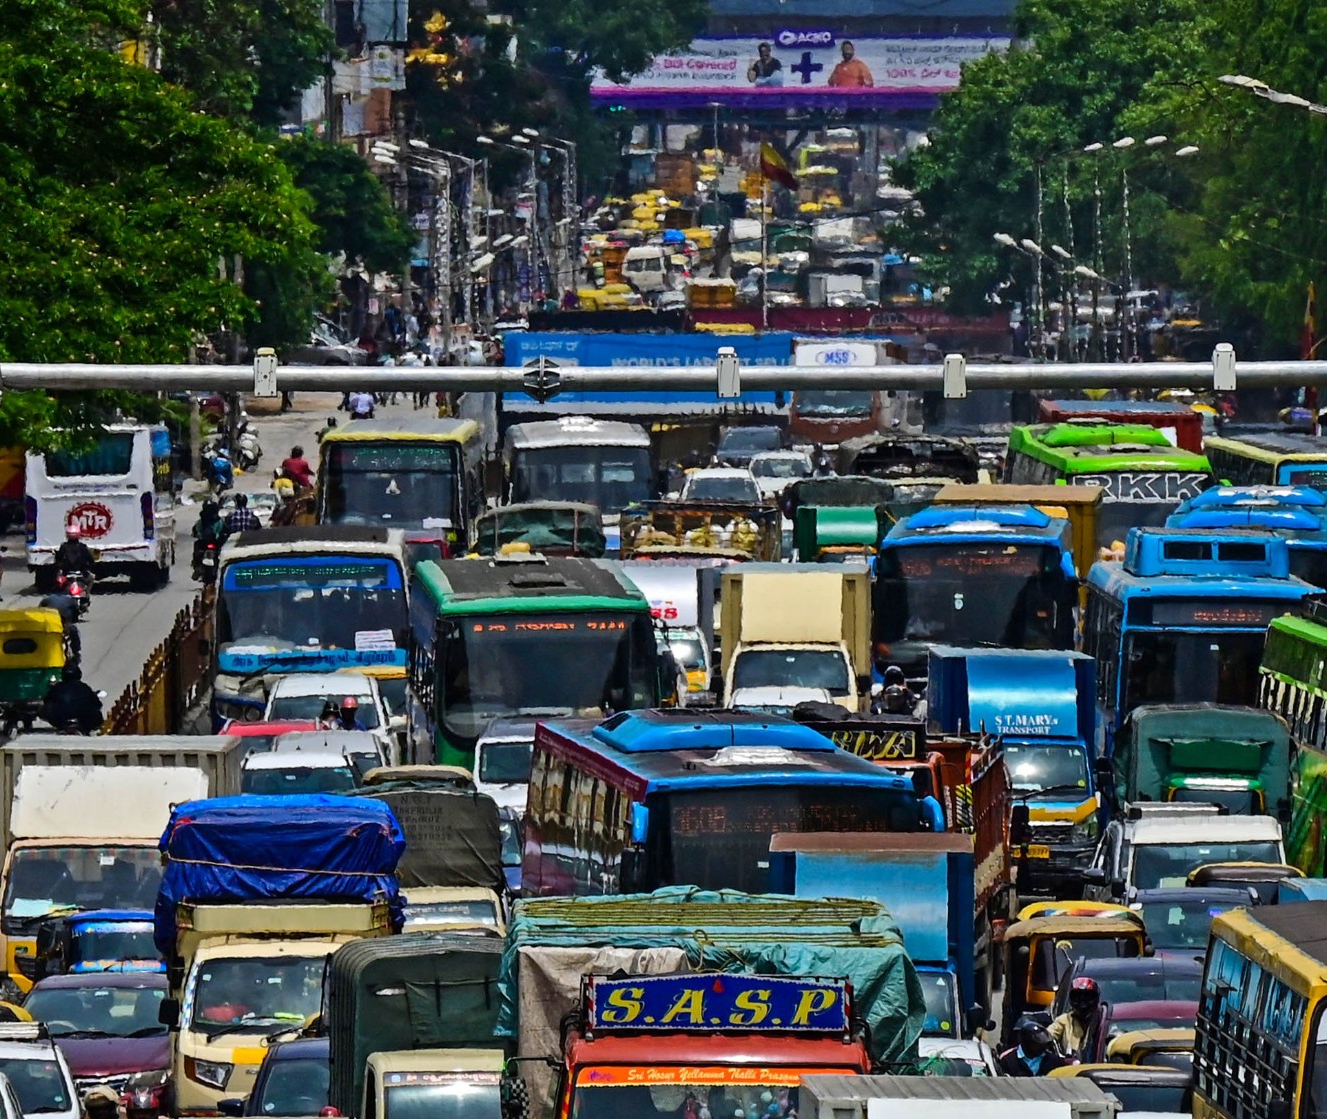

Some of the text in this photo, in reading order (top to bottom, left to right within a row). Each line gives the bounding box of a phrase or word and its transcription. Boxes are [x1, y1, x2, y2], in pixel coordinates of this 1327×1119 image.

[1072, 473, 1209, 504] RKK
[71, 510, 108, 530] MTR
[996, 726, 1052, 735] TRANSPORT
[627, 1069, 644, 1081] Sri
